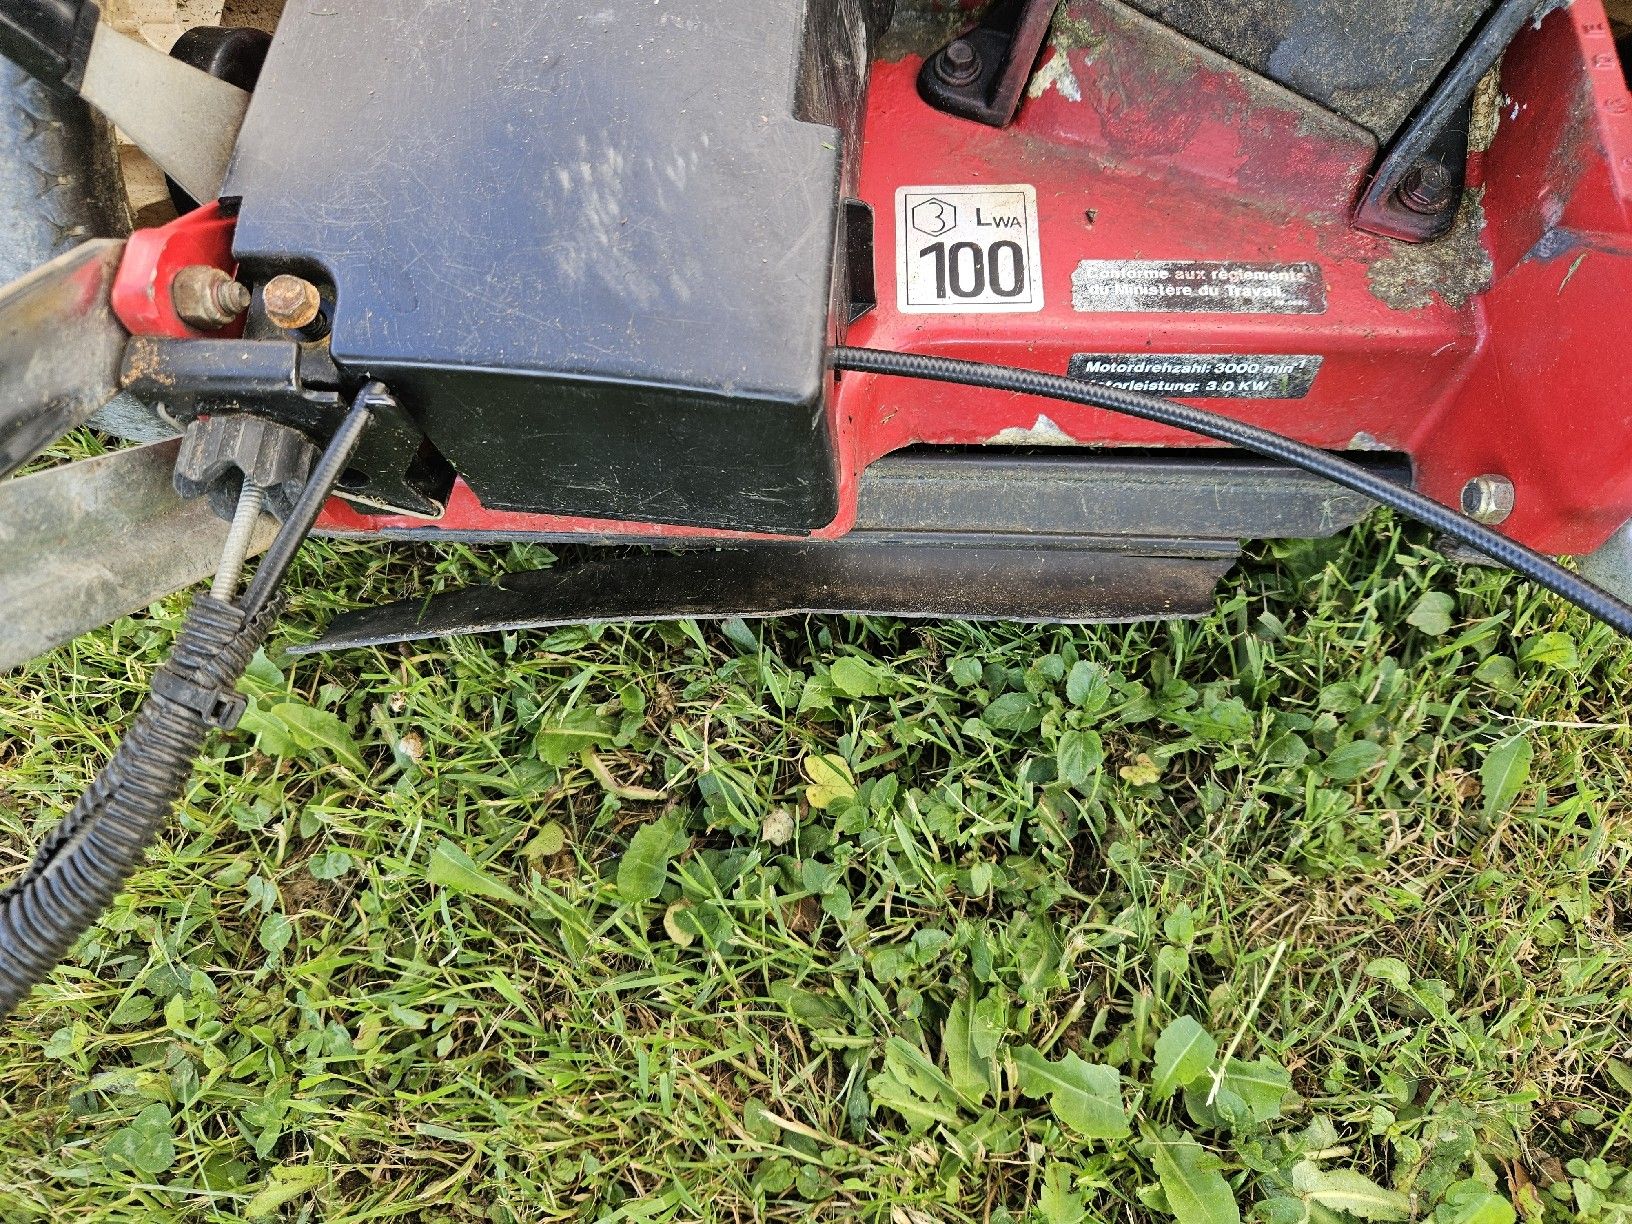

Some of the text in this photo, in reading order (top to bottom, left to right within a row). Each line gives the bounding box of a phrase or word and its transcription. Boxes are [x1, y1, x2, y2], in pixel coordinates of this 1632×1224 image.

[928, 201, 946, 233] 3
[919, 239, 1025, 299] 100
[1175, 269, 1206, 280] aux
[1198, 285, 1219, 296] du
[1085, 361, 1212, 374] Motordrehzahl:
[1213, 362, 1260, 374] 3000
[1090, 380, 1270, 393] torleistung: 3.0 KW
